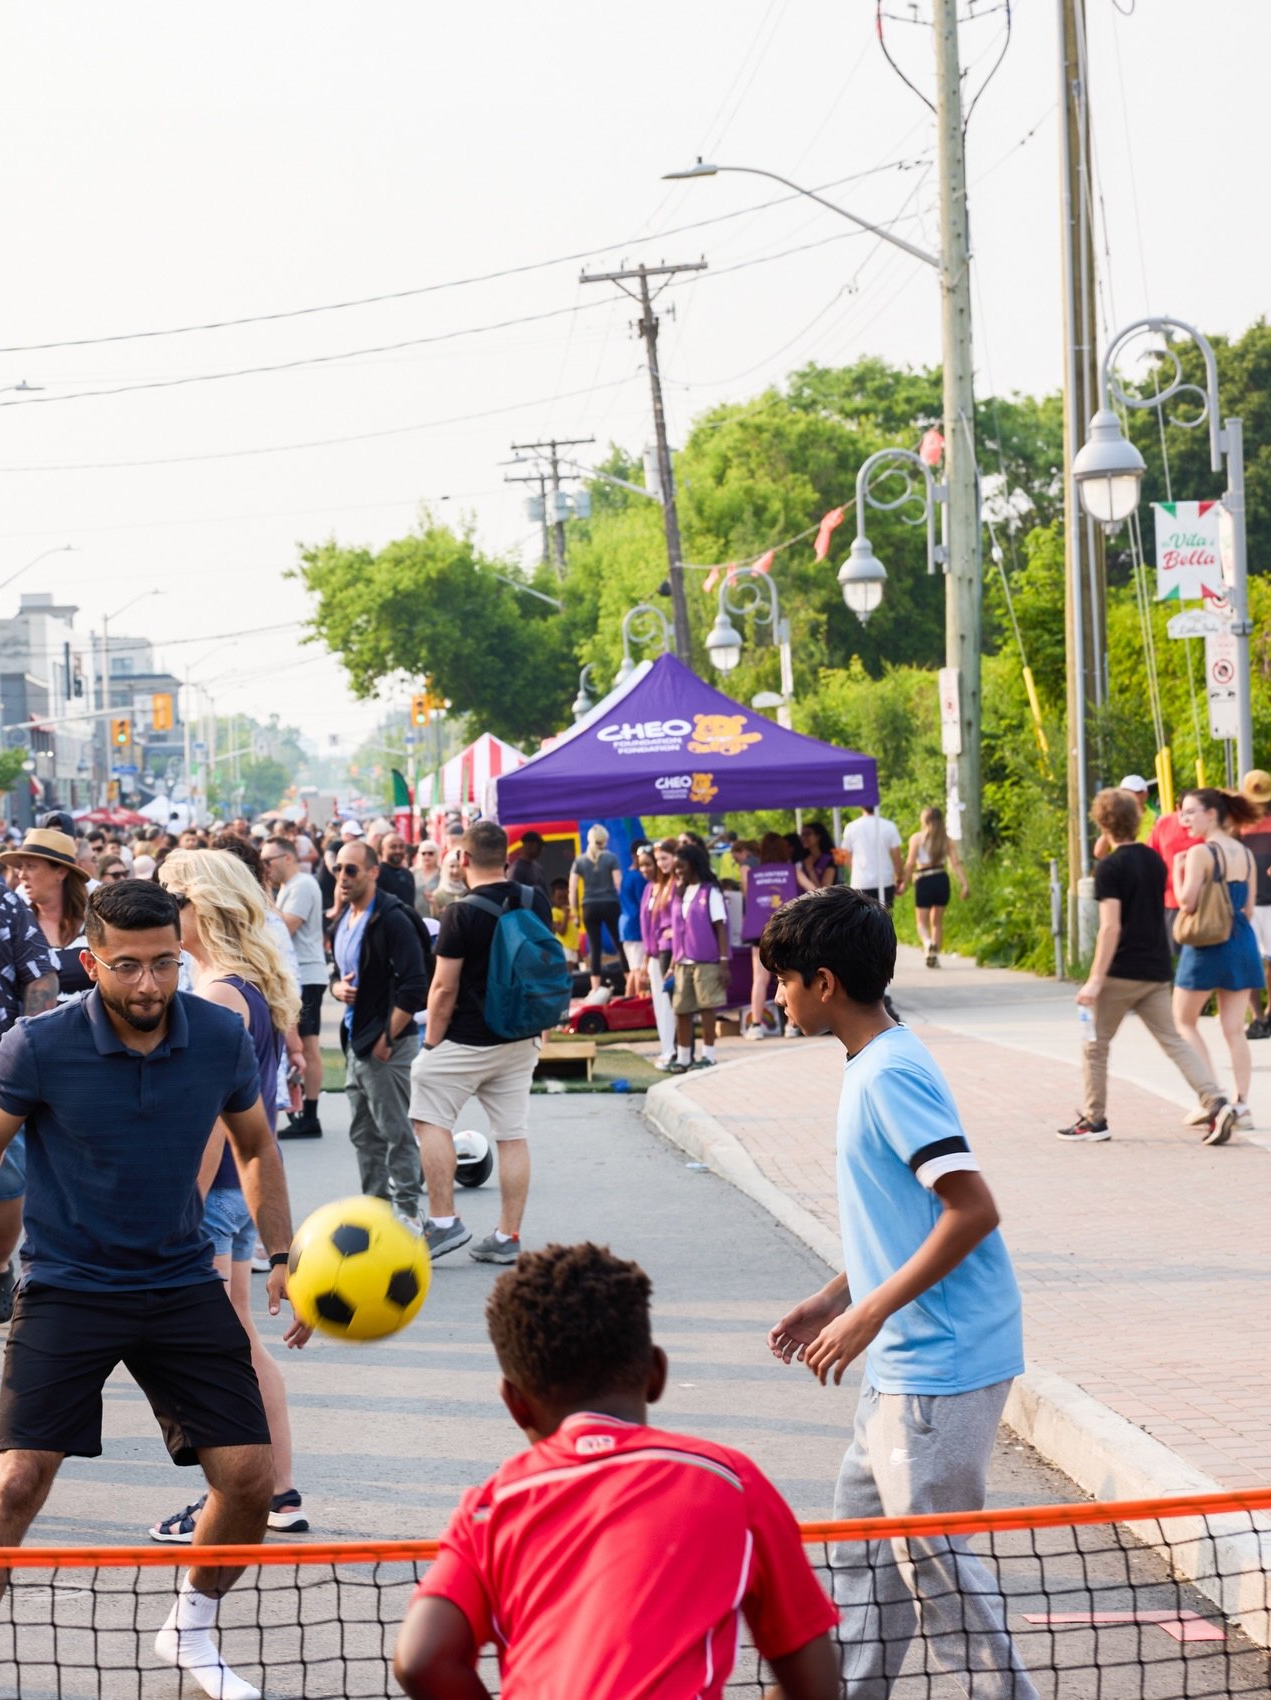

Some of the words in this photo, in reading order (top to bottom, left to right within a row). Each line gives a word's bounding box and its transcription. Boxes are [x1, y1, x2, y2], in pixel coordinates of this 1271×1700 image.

[1163, 550, 1215, 570] Bella
[596, 719, 692, 742] CHEO
[613, 737, 682, 749] FOUNDATION
[617, 744, 680, 755] FONDATION
[655, 775, 692, 790] CHEO
